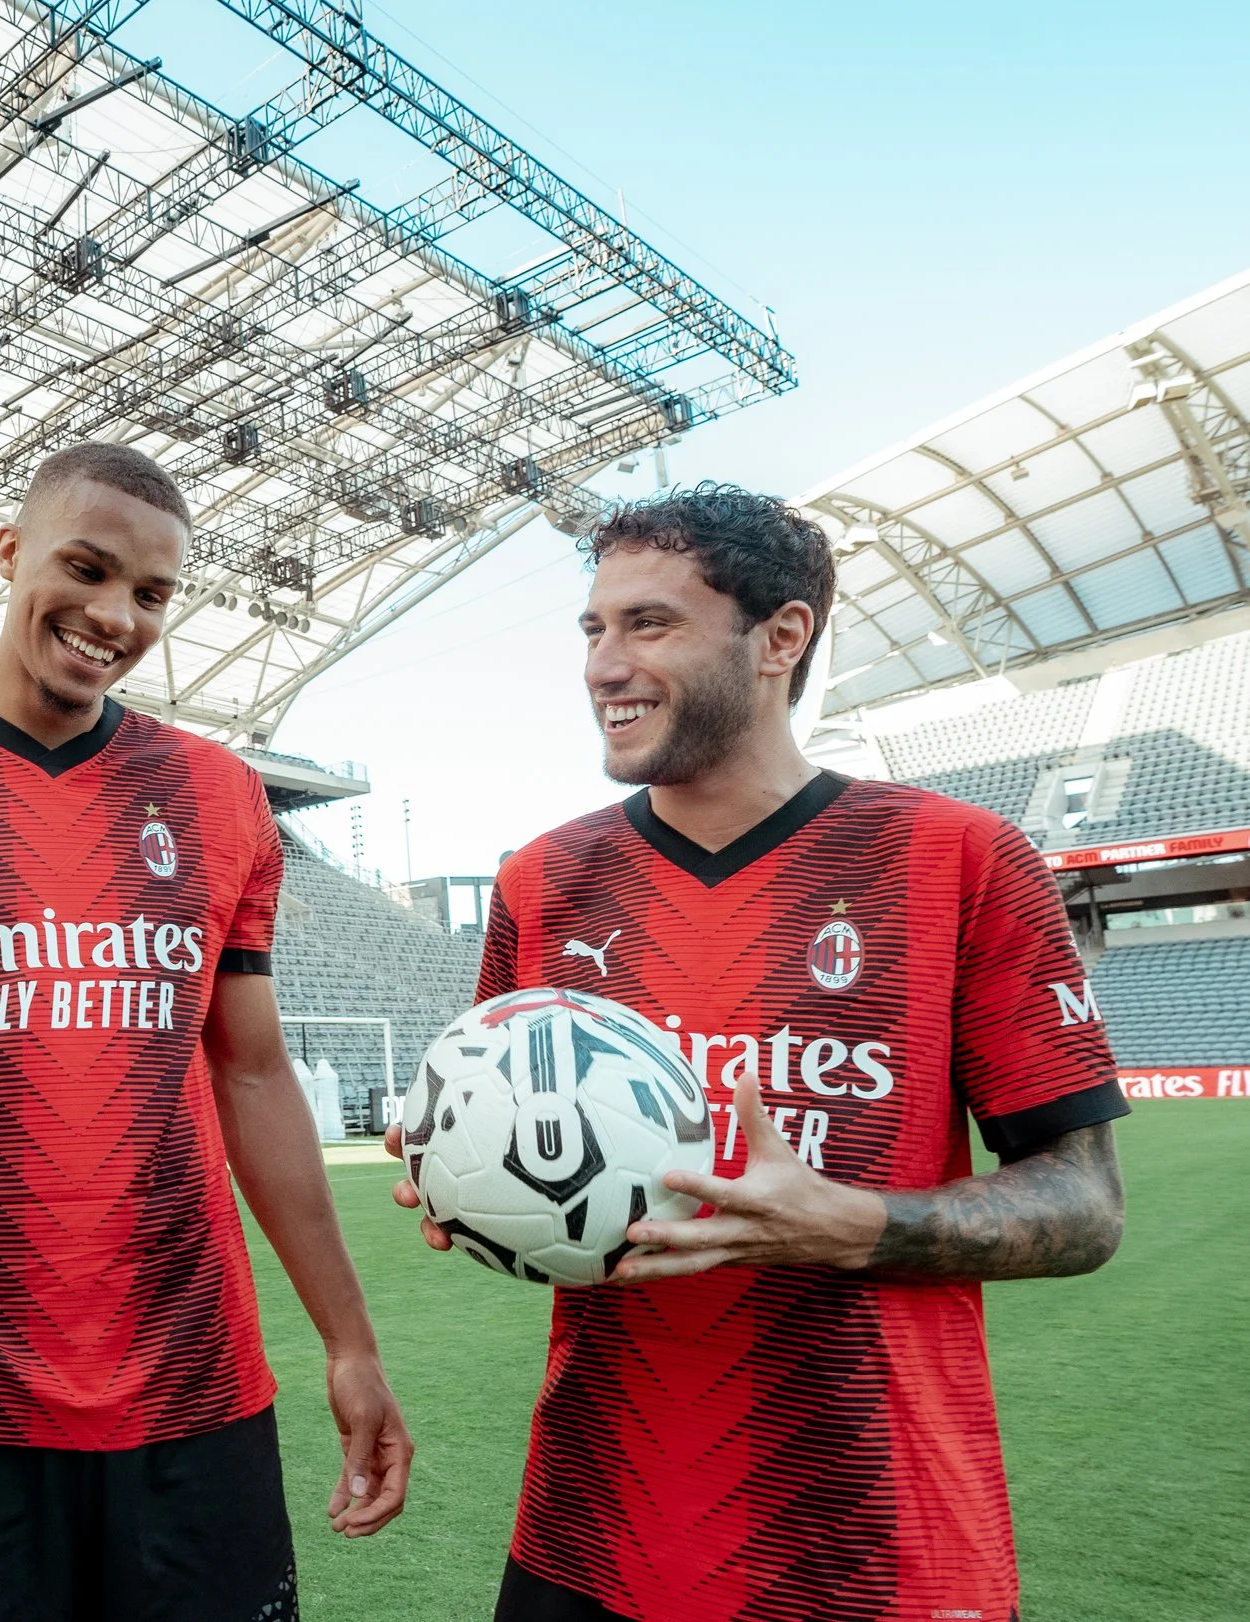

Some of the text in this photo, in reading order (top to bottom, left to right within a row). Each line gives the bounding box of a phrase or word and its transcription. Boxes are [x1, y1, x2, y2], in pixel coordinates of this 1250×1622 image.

[1067, 852, 1099, 864] ACM
[1100, 843, 1167, 861] PARTNER
[1169, 837, 1224, 853] FAMILY
[821, 923, 853, 938] ACM
[819, 974, 848, 984] 1899
[50, 980, 175, 1031] BETTER
